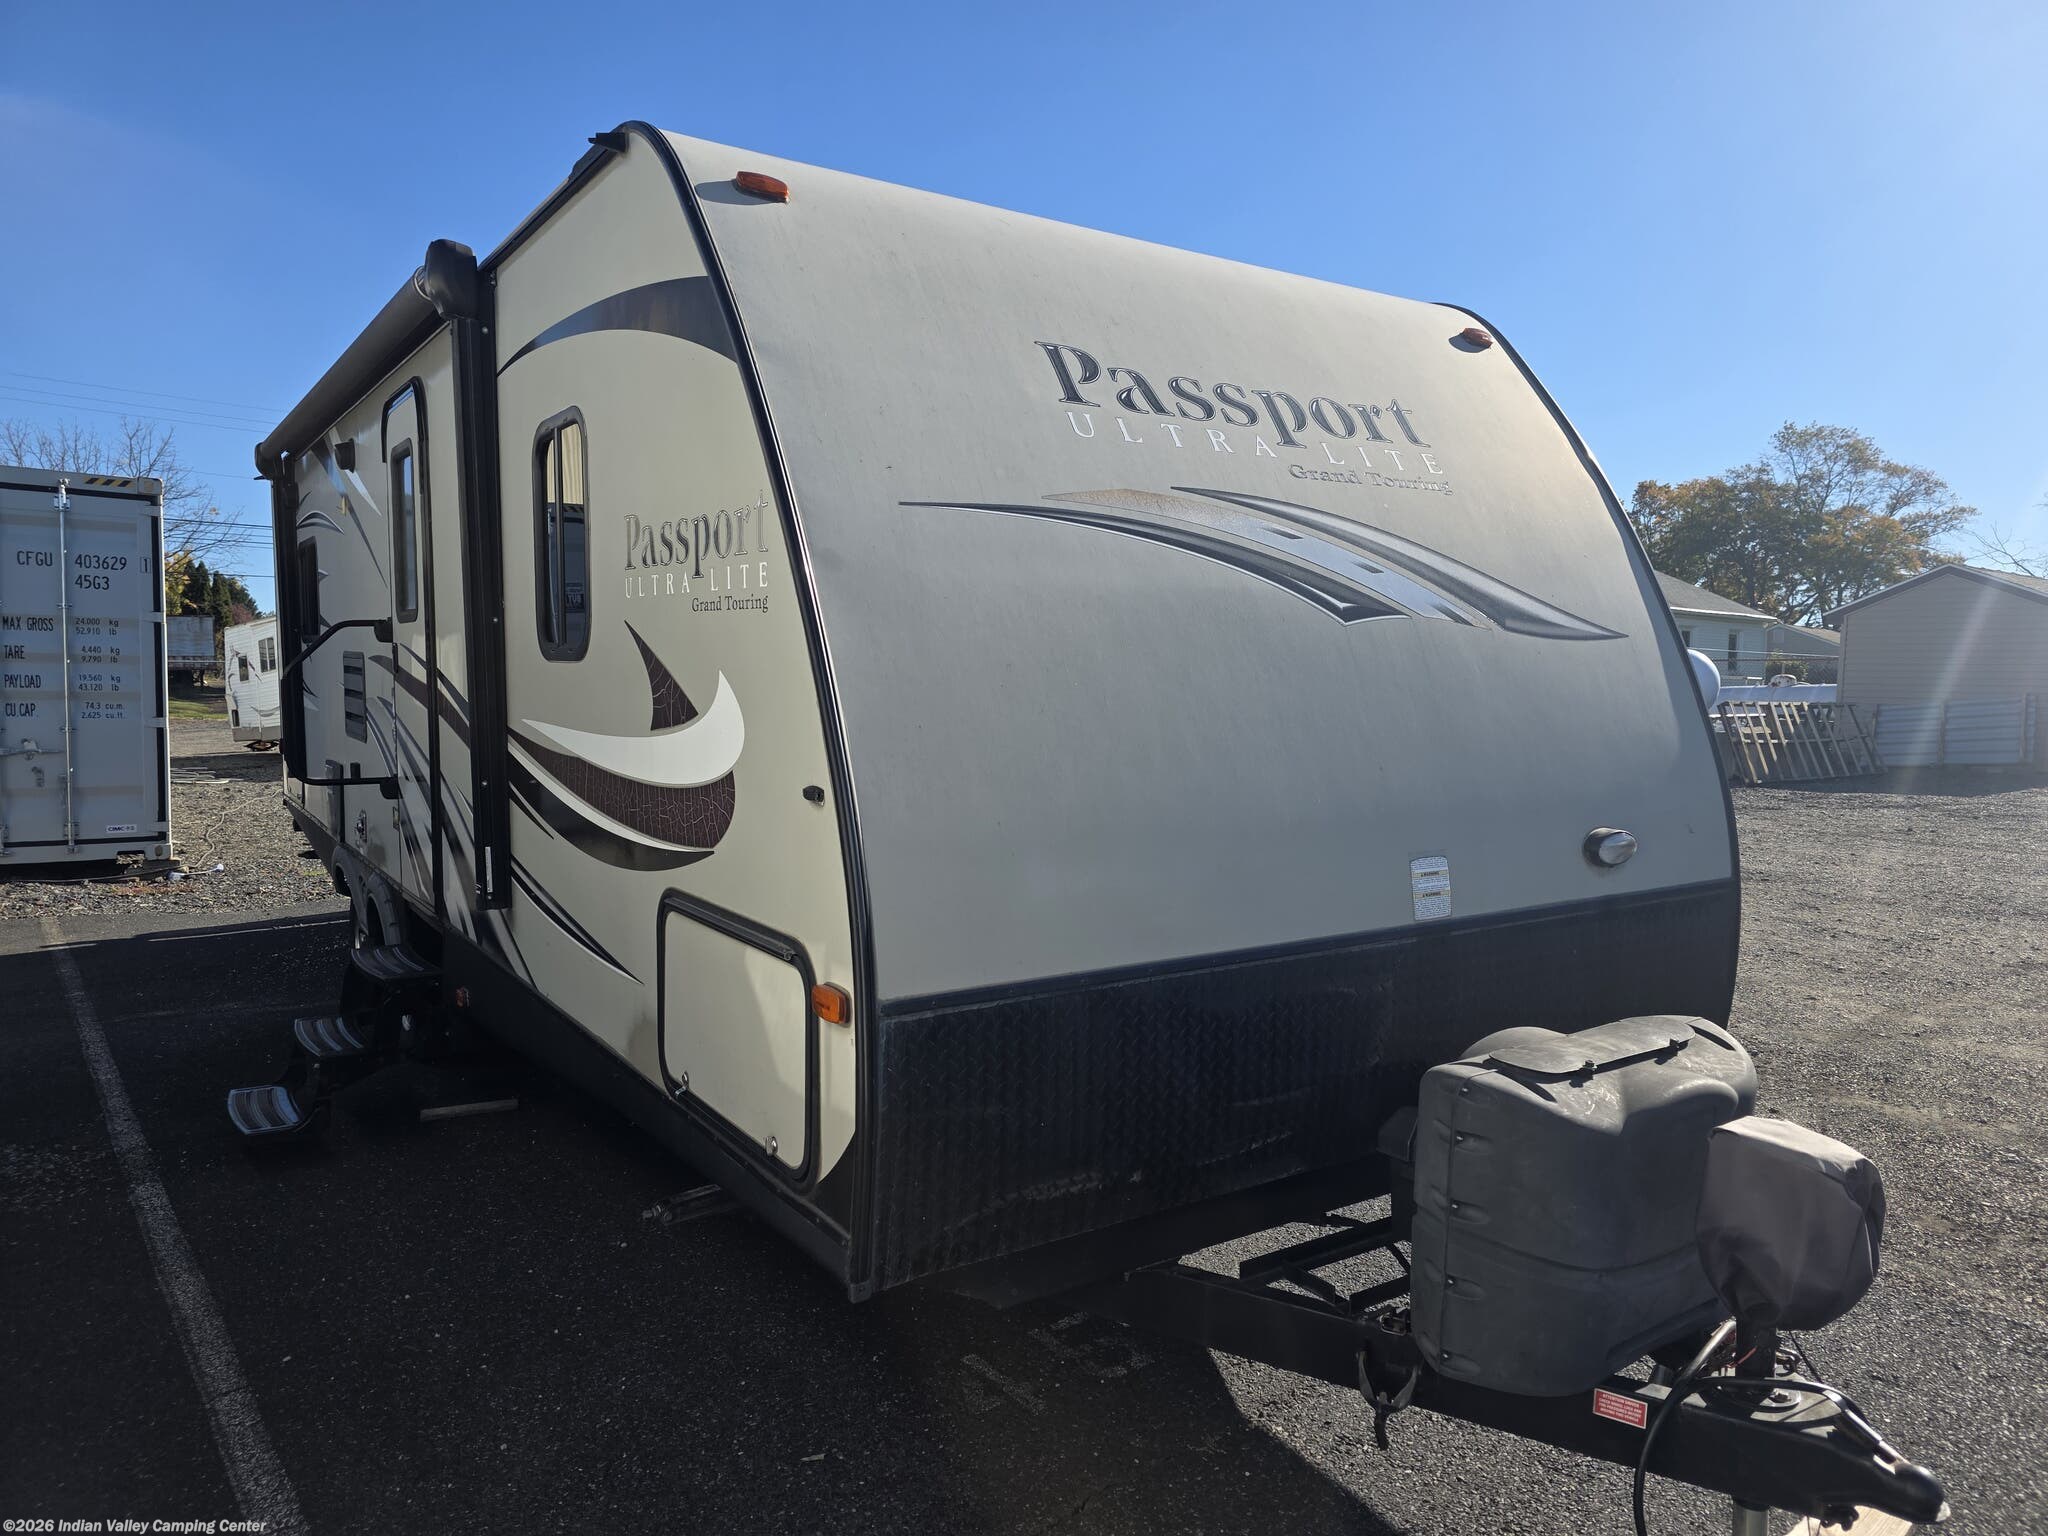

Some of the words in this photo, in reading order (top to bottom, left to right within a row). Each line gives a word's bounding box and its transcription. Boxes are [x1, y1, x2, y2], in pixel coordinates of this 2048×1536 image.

[1034, 341, 1430, 448] Passport
[1065, 411, 1278, 458] ULTRA
[1320, 442, 1443, 474] LITE
[1288, 464, 1362, 484] Grand
[1364, 471, 1454, 496] Touring
[624, 489, 769, 579] Passport
[16, 550, 53, 567] CFGU
[74, 554, 128, 571] 403629
[74, 574, 110, 590] 45G3
[625, 571, 690, 598] ULTRA
[710, 562, 768, 591] LITE
[691, 596, 722, 612] Grand
[725, 594, 769, 613] Touring
[2, 616, 21, 630] MAX
[26, 617, 54, 632] GROSS
[109, 619, 119, 628] kg
[109, 628, 117, 636] lb
[4, 645, 25, 660] TARE
[110, 646, 120, 656] kg
[4, 674, 42, 688] PAYLOAD
[111, 674, 120, 683] kg
